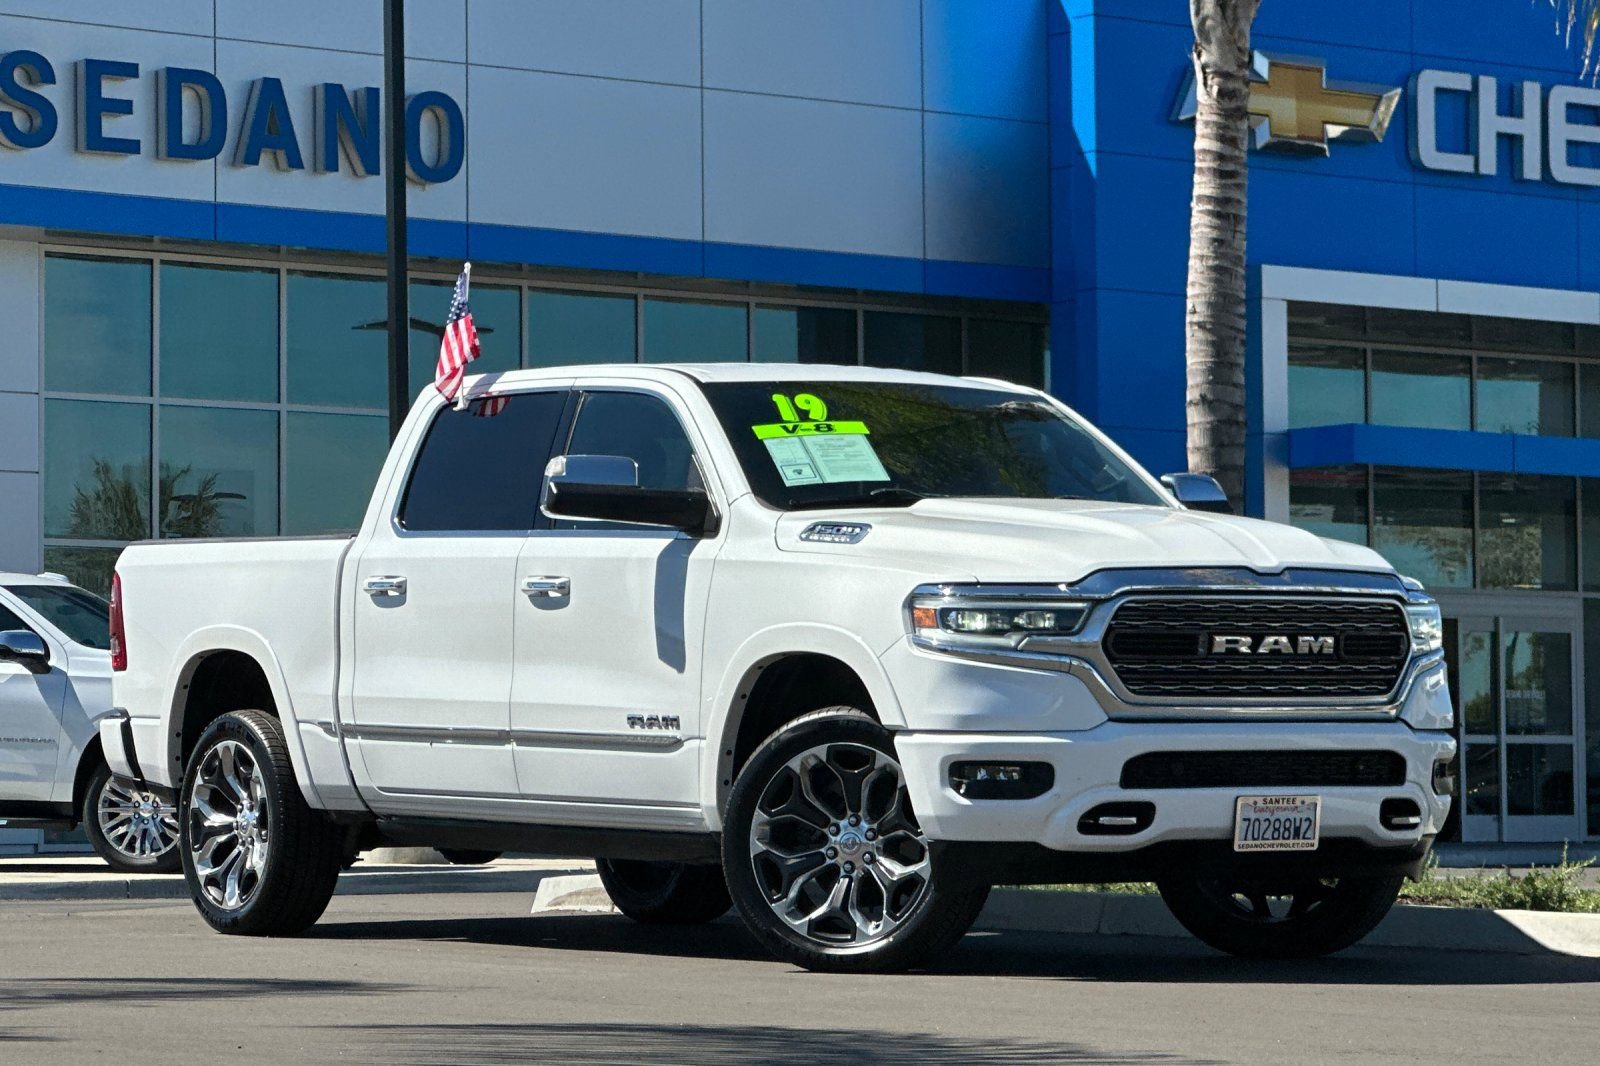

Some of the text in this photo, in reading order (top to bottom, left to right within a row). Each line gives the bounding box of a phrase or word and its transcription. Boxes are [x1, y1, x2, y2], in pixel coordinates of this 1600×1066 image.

[0, 50, 465, 186] SEDANO
[1413, 69, 1600, 187] CHE
[772, 393, 827, 422] 19
[780, 423, 834, 434] V-8
[1212, 635, 1335, 654] RAM
[627, 714, 680, 730] RAM
[1241, 817, 1313, 841] 70288W2
[1237, 842, 1315, 851] SEDANOCHEVROLET.COM
